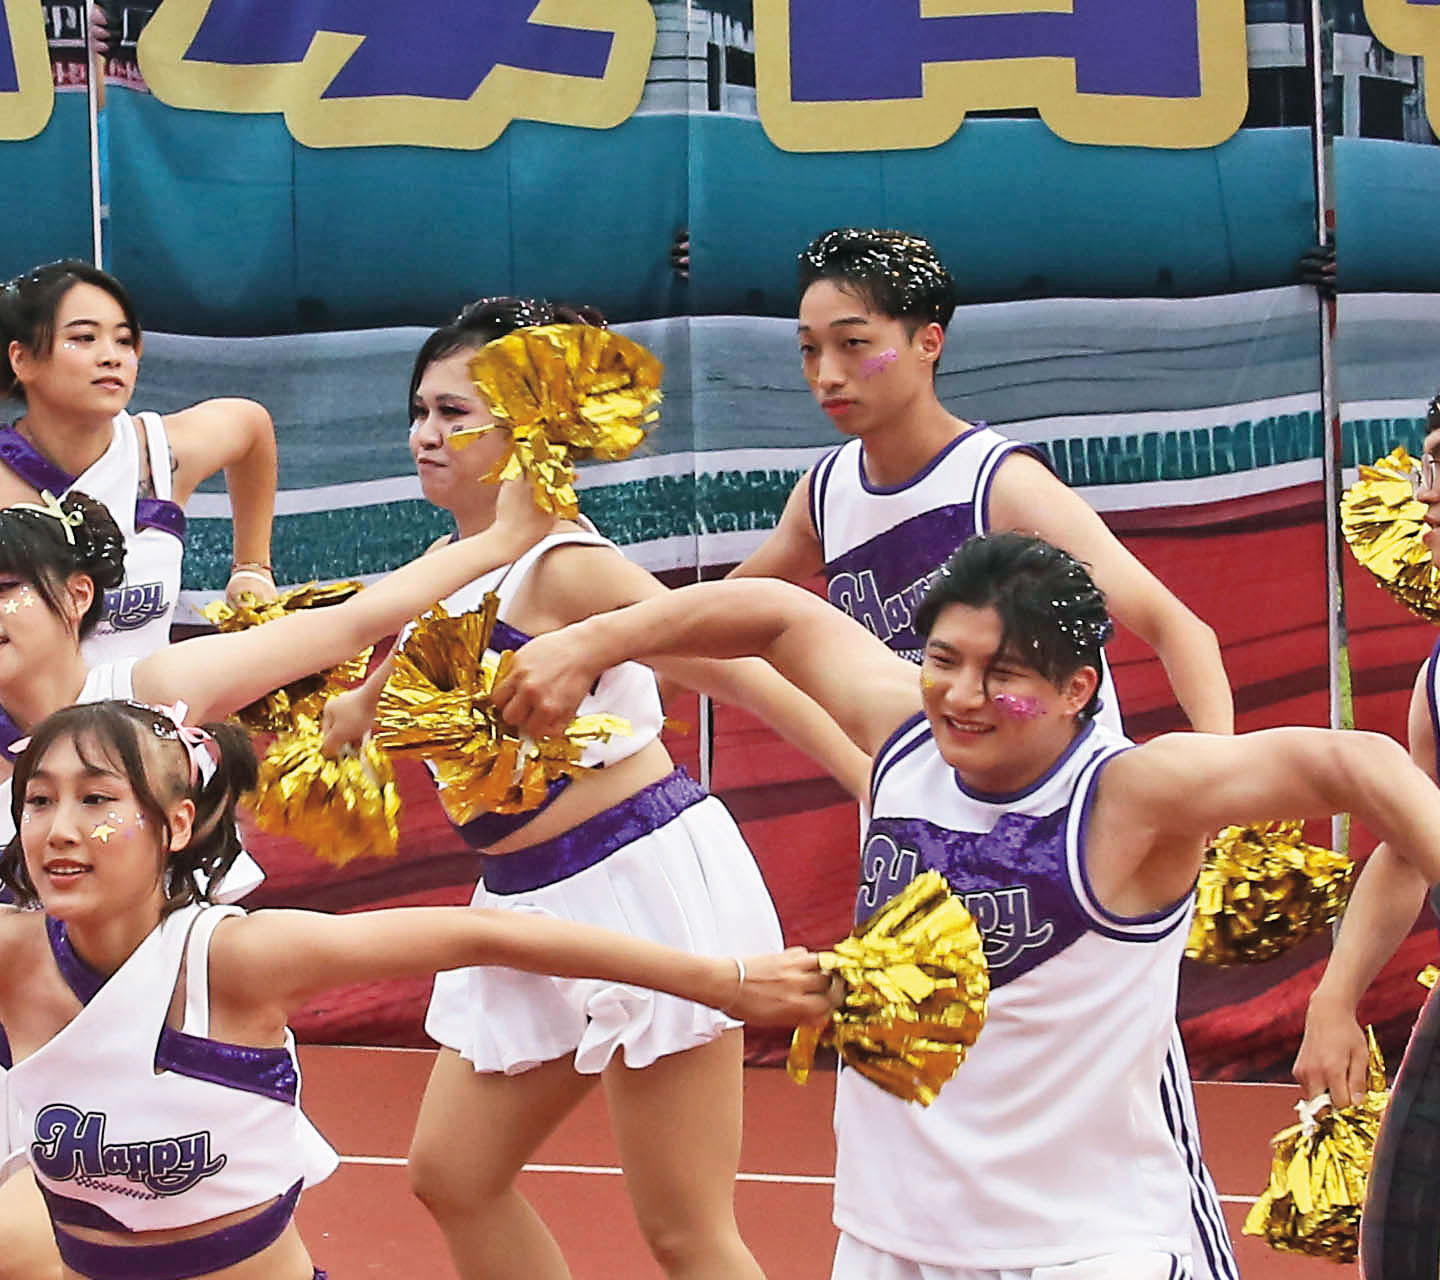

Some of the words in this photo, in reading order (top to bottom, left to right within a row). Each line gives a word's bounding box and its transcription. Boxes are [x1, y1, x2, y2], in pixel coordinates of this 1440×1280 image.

[104, 581, 170, 630] ppy
[857, 834, 1053, 968] Hpy
[33, 1103, 226, 1196] Happy
